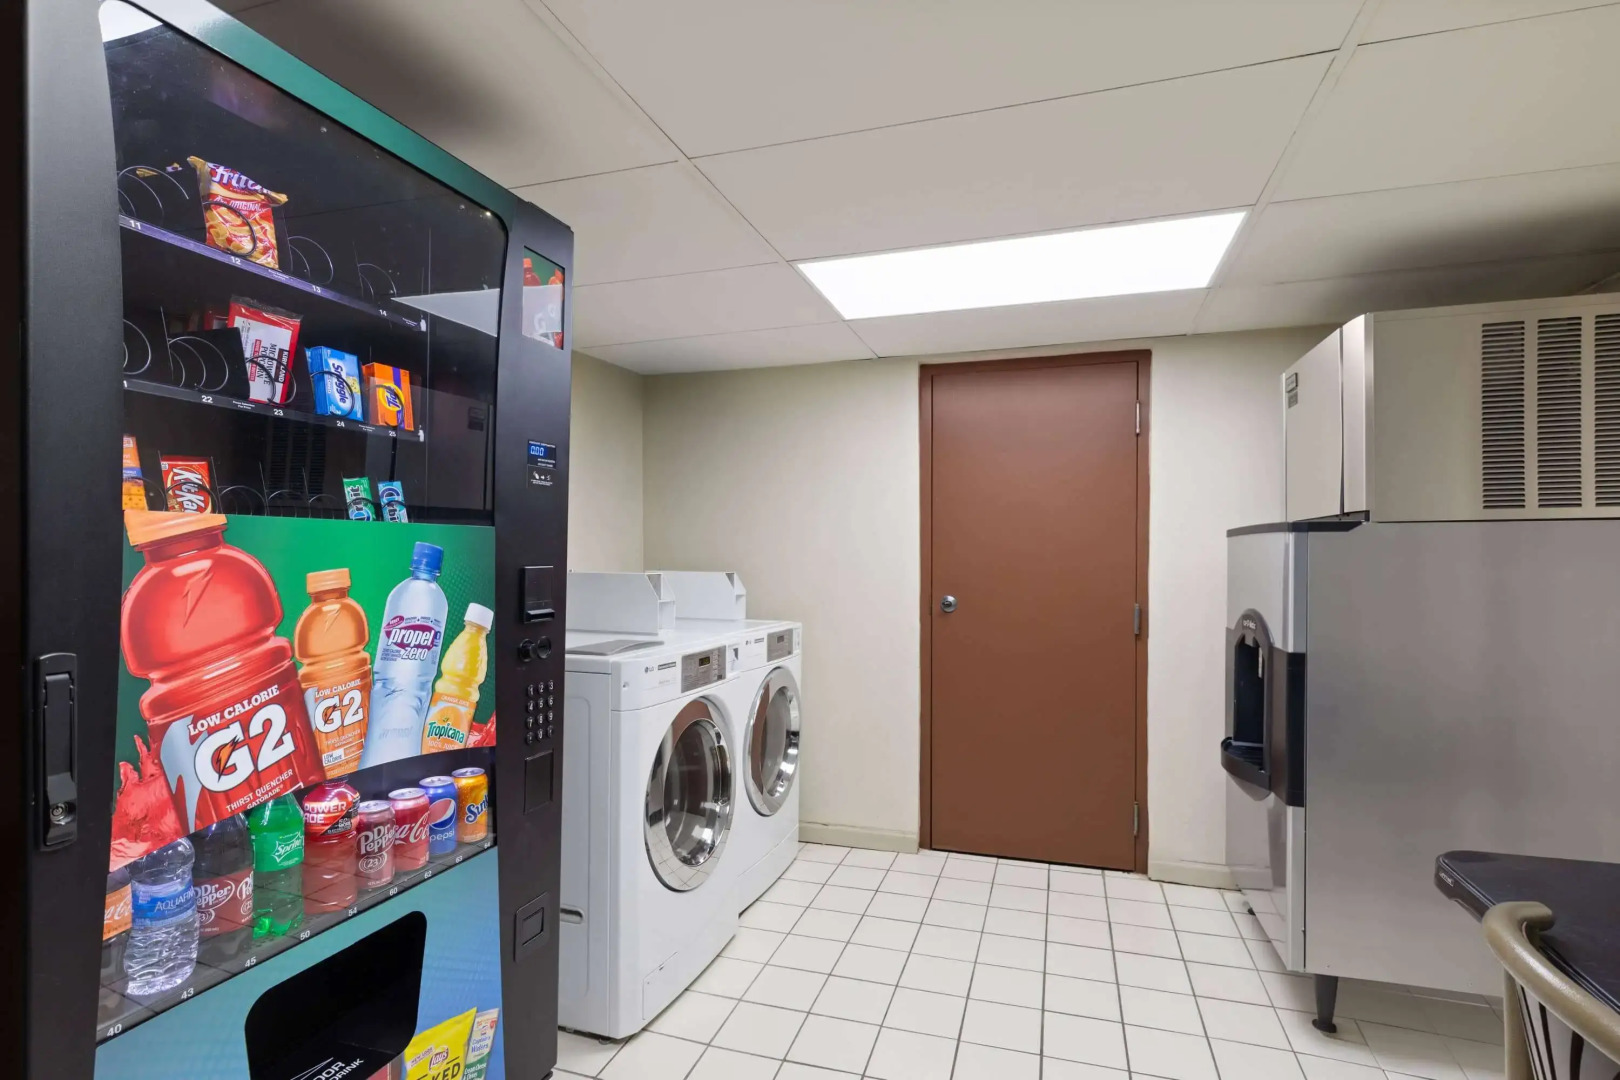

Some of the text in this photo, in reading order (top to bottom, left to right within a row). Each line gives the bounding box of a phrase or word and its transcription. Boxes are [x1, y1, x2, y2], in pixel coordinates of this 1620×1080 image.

[207, 162, 266, 190] Frito
[129, 220, 141, 229] 11
[230, 256, 241, 265] 12
[257, 346, 268, 379] POCRN
[264, 343, 277, 385] MICOWVE
[202, 395, 213, 403] 22
[385, 385, 401, 408] Tide
[387, 628, 434, 648] propel
[400, 647, 428, 661] zero
[315, 679, 361, 698] LOW CALORIE
[188, 685, 280, 736] LOW CALORIE
[314, 689, 364, 733] G2
[427, 721, 465, 743] Tropicana
[194, 703, 296, 794] G2
[226, 769, 293, 812] THIRST QUENCHER
[304, 801, 346, 814] POWER
[373, 824, 391, 840] Dr
[430, 830, 454, 843] pepsi
[368, 859, 378, 867] 23
[154, 886, 194, 912] AQUAFIN
[201, 884, 219, 899] Dr
[389, 887, 397, 896] 60
[348, 907, 357, 916] 54
[300, 930, 311, 940] 50
[245, 957, 257, 967] 45
[181, 988, 194, 999] 43
[107, 1024, 122, 1036] 40
